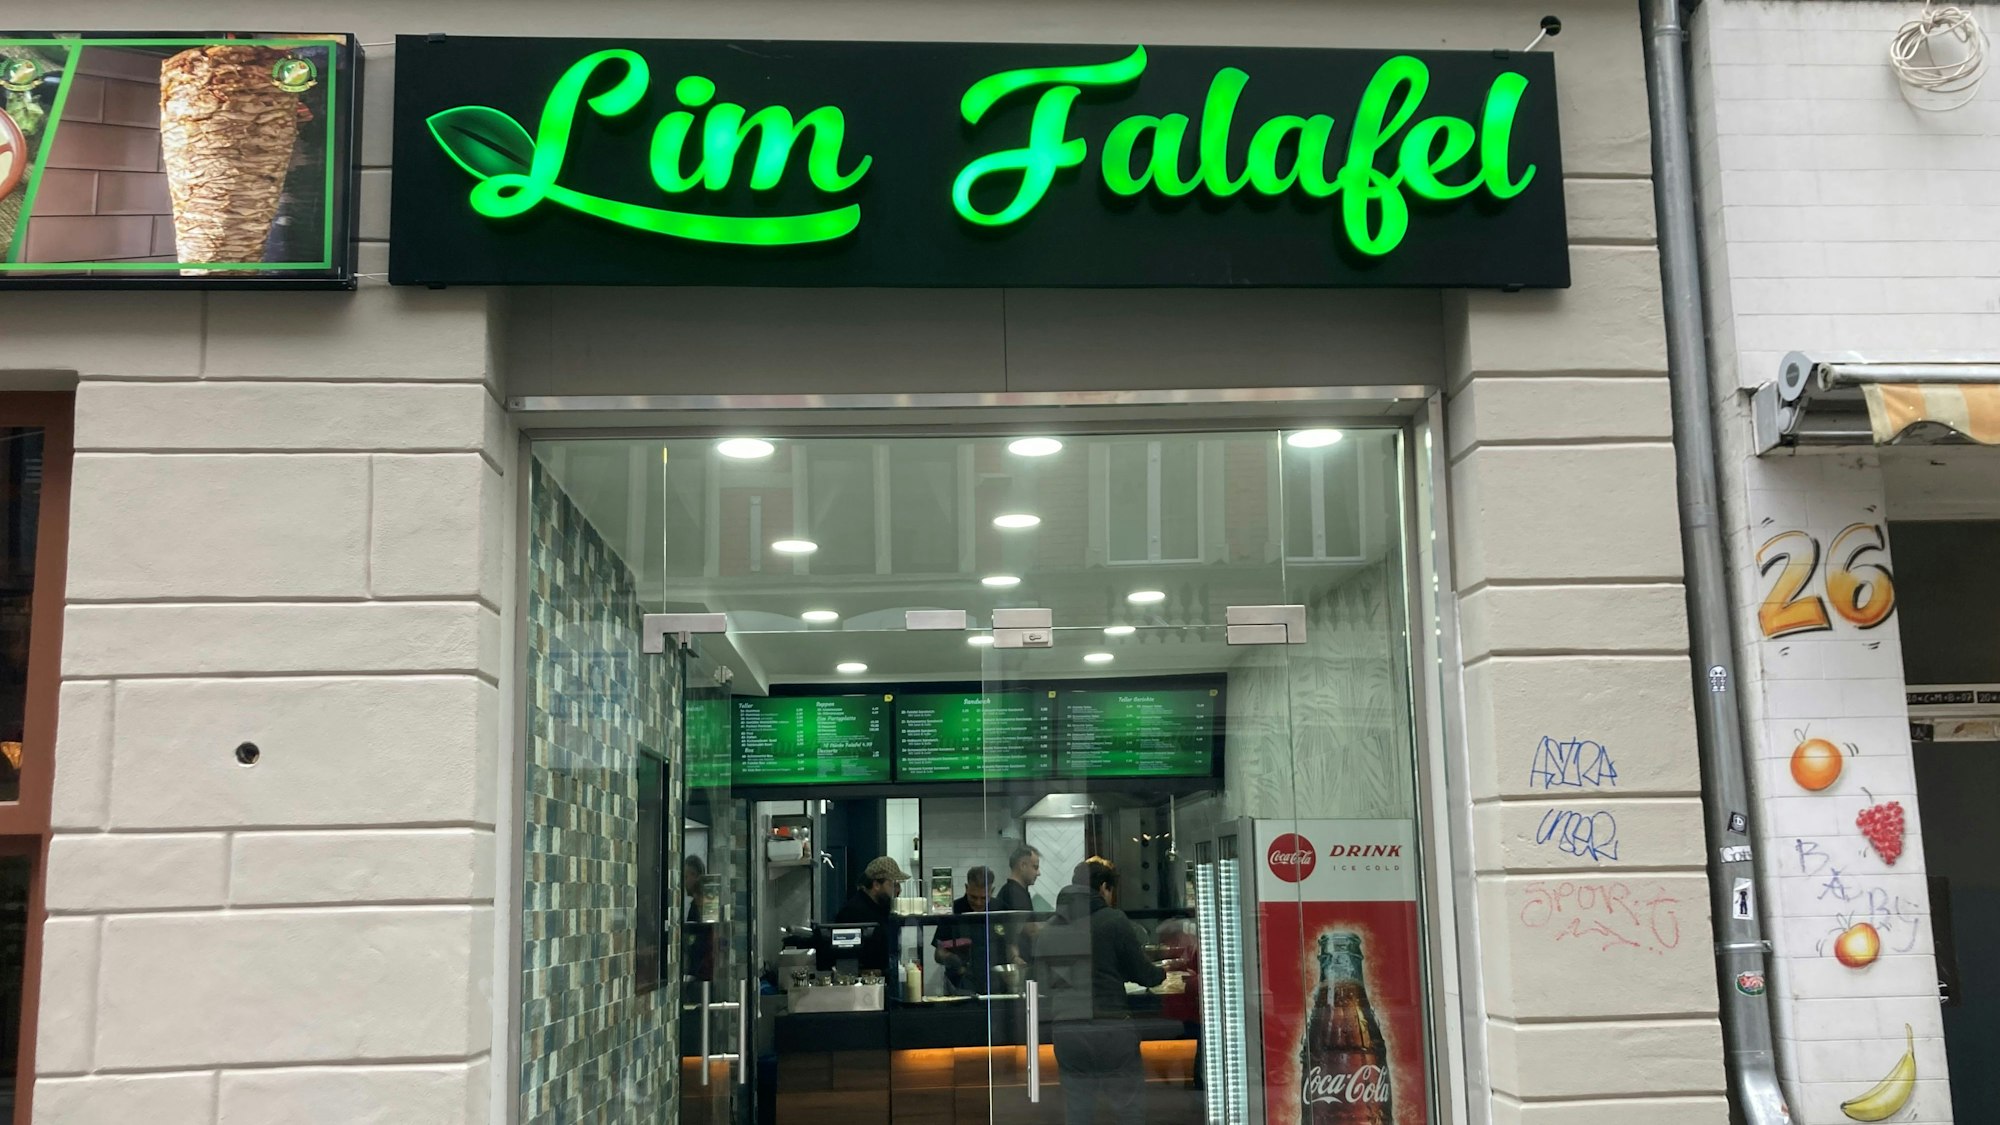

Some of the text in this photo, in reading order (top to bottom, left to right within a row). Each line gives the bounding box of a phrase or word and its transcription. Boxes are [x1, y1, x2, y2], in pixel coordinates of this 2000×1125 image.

[470, 44, 1538, 256] Lim Falafel
[1756, 522, 1896, 640] 26
[1270, 849, 1314, 865] Coca-Cola
[1329, 844, 1403, 858] DRINK
[1302, 1064, 1389, 1105] Coca-Cola
